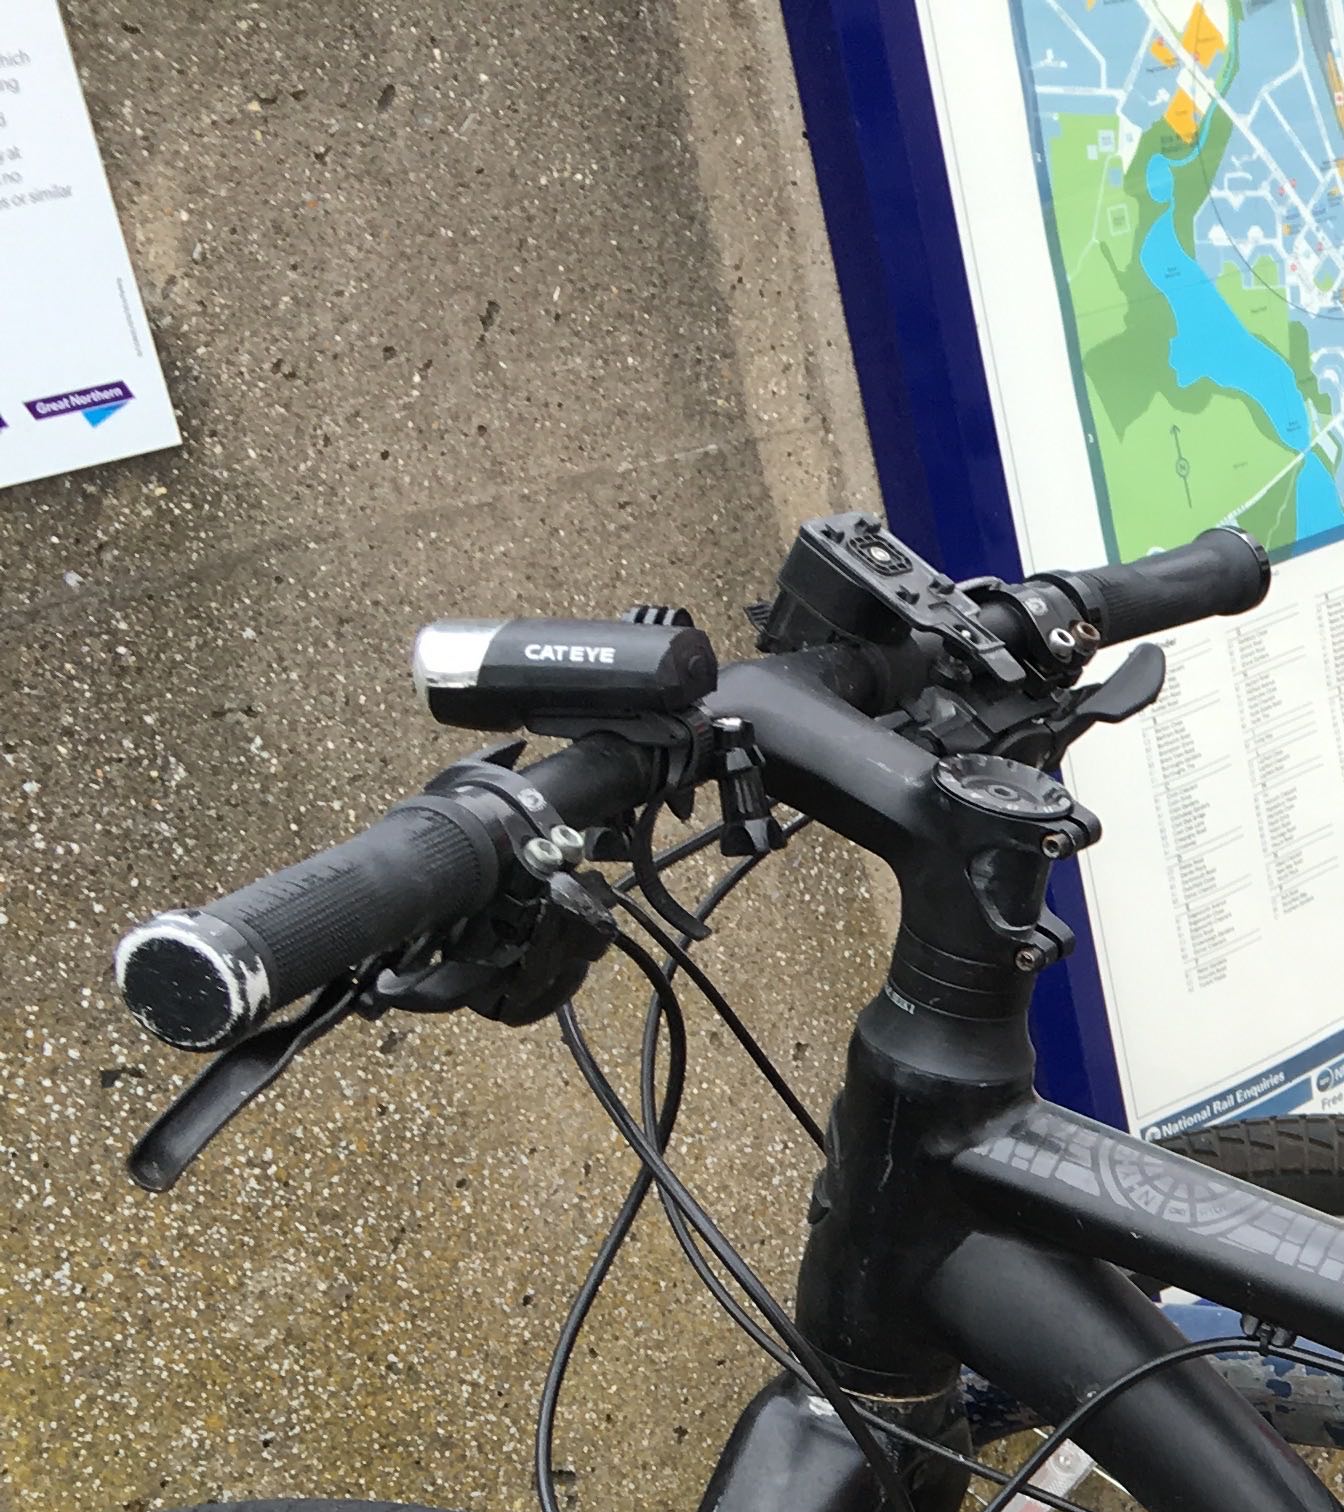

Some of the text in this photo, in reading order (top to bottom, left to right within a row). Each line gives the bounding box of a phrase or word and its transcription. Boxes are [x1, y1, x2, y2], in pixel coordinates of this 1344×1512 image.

[35, 386, 124, 415] Great Northern
[524, 644, 616, 664] CATEYE
[1162, 1070, 1285, 1137] National Rail Enquiries
[1321, 1092, 1344, 1111] Free
